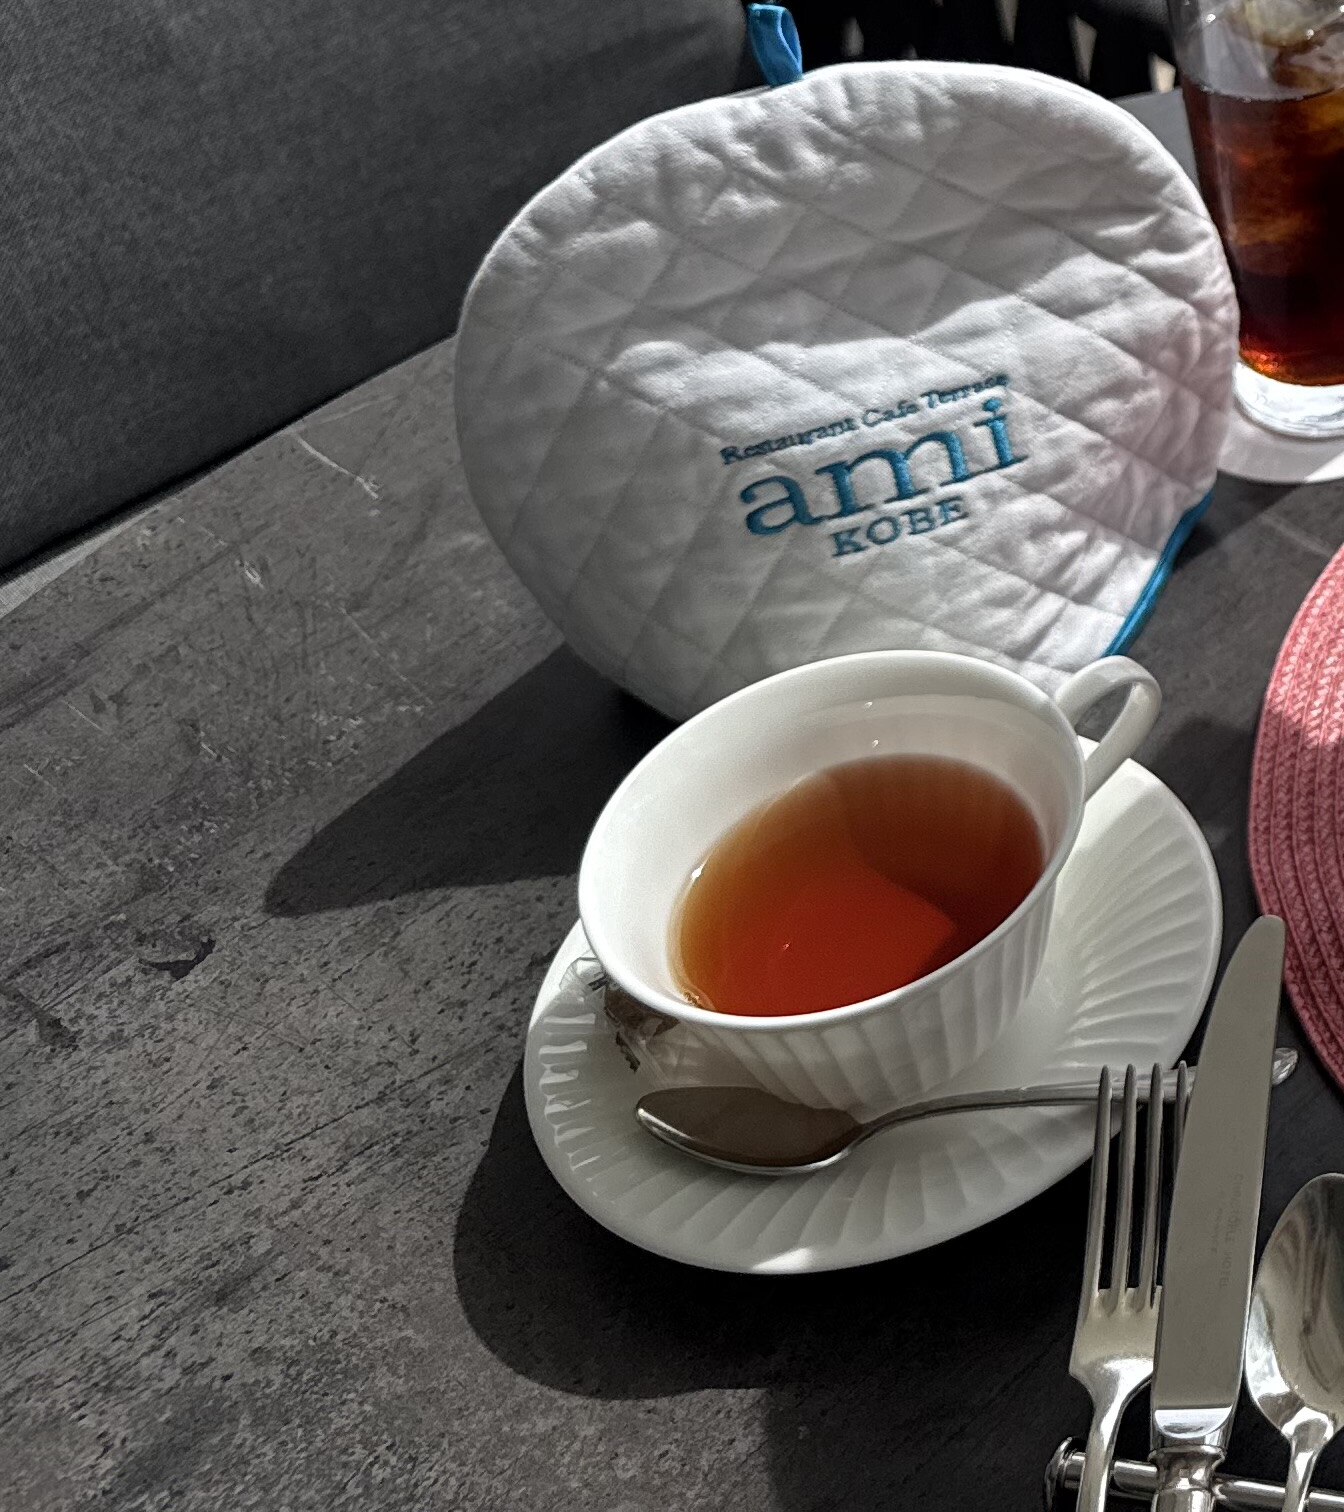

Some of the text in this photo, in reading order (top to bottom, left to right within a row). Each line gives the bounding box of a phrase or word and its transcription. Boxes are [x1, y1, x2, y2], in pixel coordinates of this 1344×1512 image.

[720, 373, 1010, 465] Restaurant Cafe Terrace
[739, 397, 1029, 536] ami
[831, 495, 969, 558] KOBE
